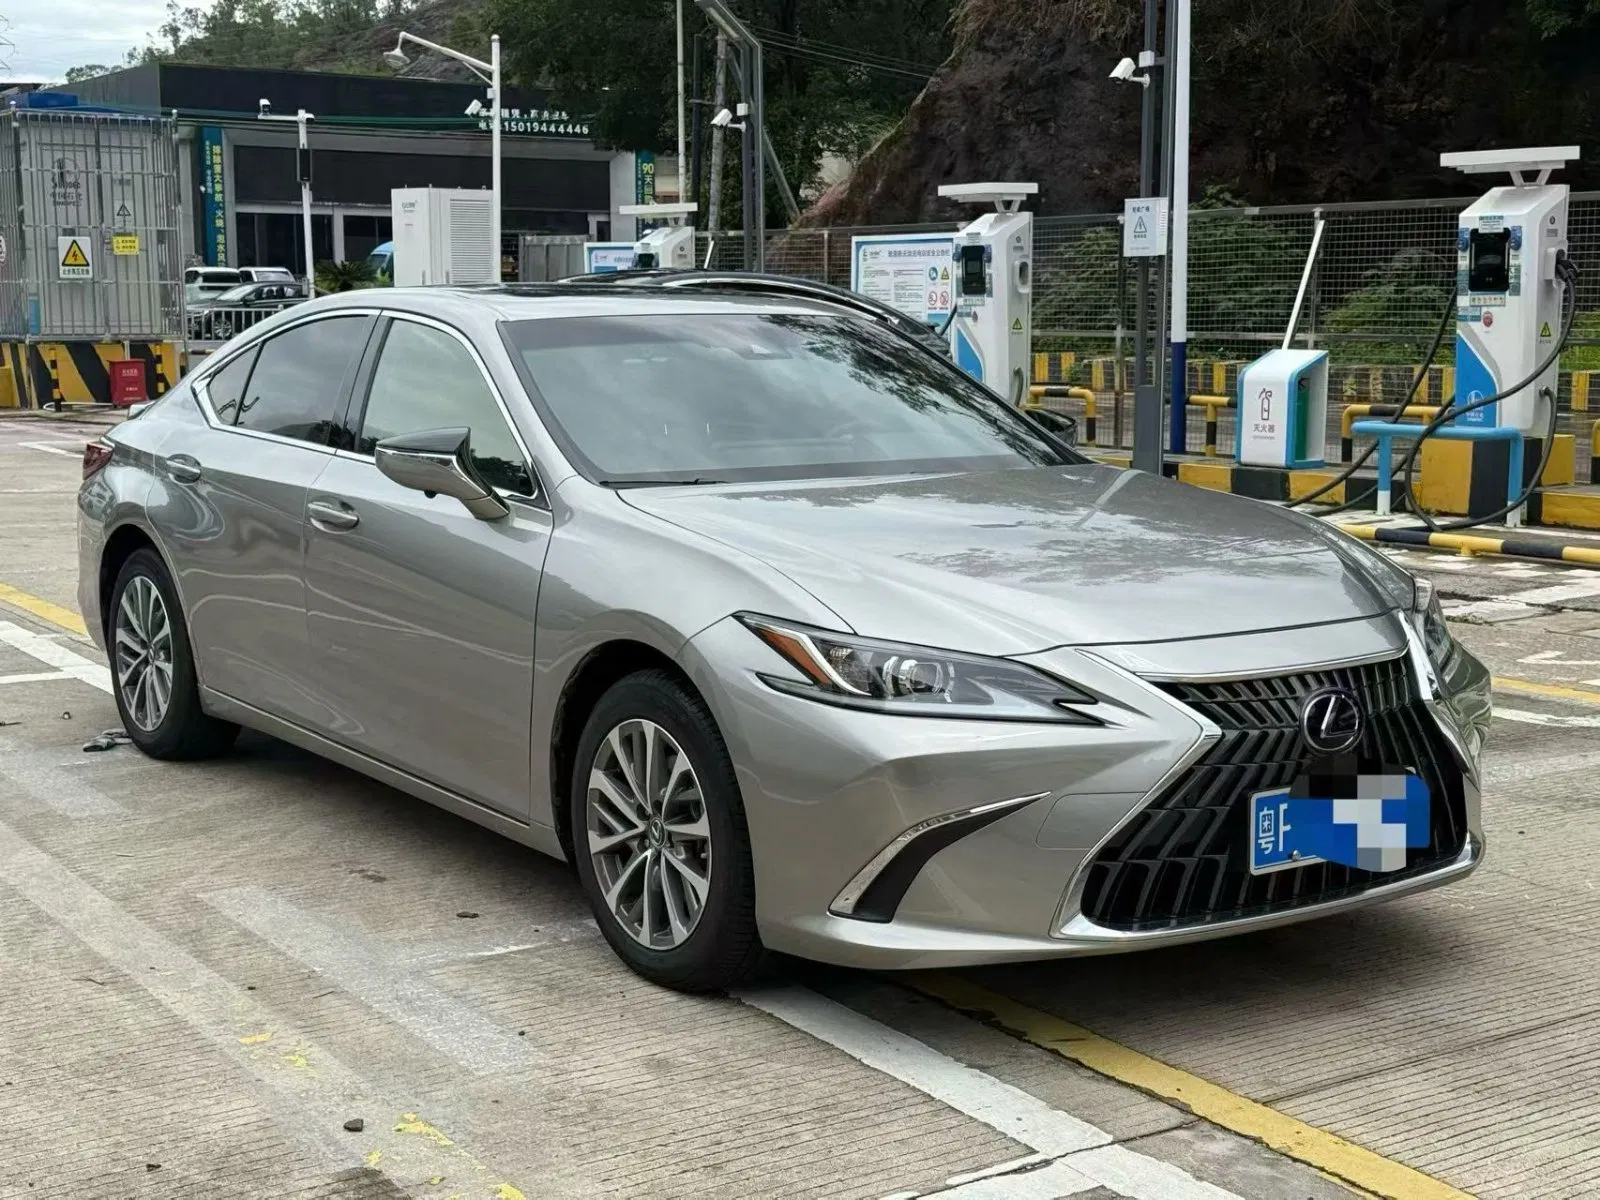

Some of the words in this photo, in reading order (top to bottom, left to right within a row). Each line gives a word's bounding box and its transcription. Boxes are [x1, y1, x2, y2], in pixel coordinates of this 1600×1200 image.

[503, 121, 589, 135] 15019444446
[1253, 423, 1275, 433] 灭火器
